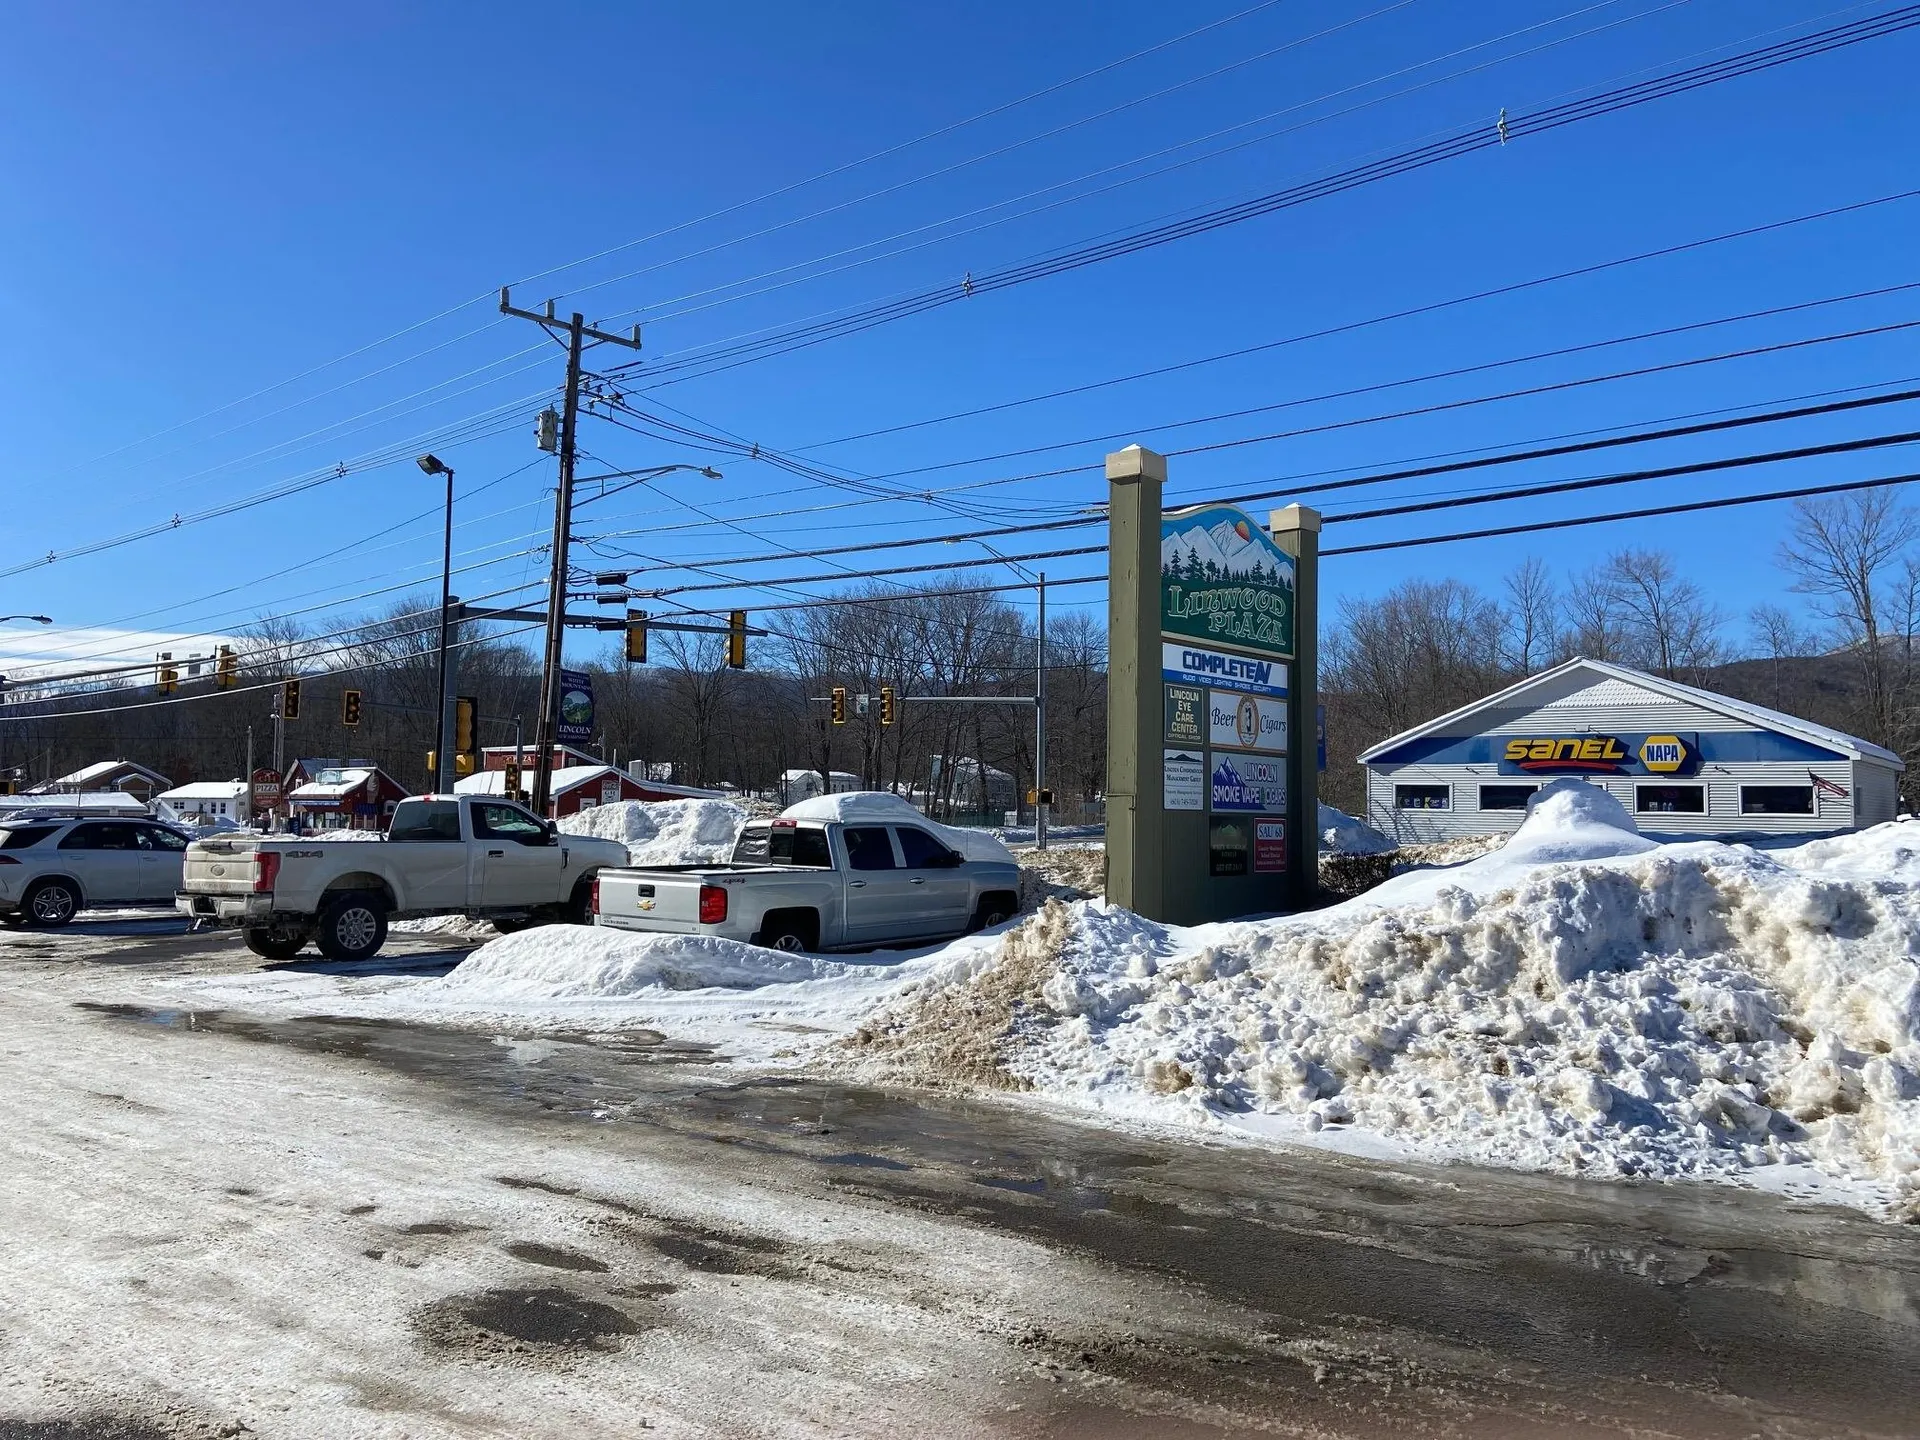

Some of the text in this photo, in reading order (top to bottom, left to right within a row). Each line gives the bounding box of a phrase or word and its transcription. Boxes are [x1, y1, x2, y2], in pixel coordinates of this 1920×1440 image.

[1208, 611, 1286, 645] PLAZA
[1170, 688, 1200, 701] LINCOLN
[1178, 701, 1192, 711] EYE
[1175, 711, 1194, 723] CARE
[1211, 707, 1287, 733] Beer Cigars
[559, 725, 592, 734] LINCOLN
[1171, 722, 1198, 734] CENTER
[1646, 745, 1679, 762] NAPA
[1244, 762, 1278, 783] LINCOLN
[256, 784, 278, 792] PIZZA
[1213, 785, 1240, 803] SMOKE
[1241, 786, 1260, 804] VAPE
[1258, 825, 1272, 838] SAU
